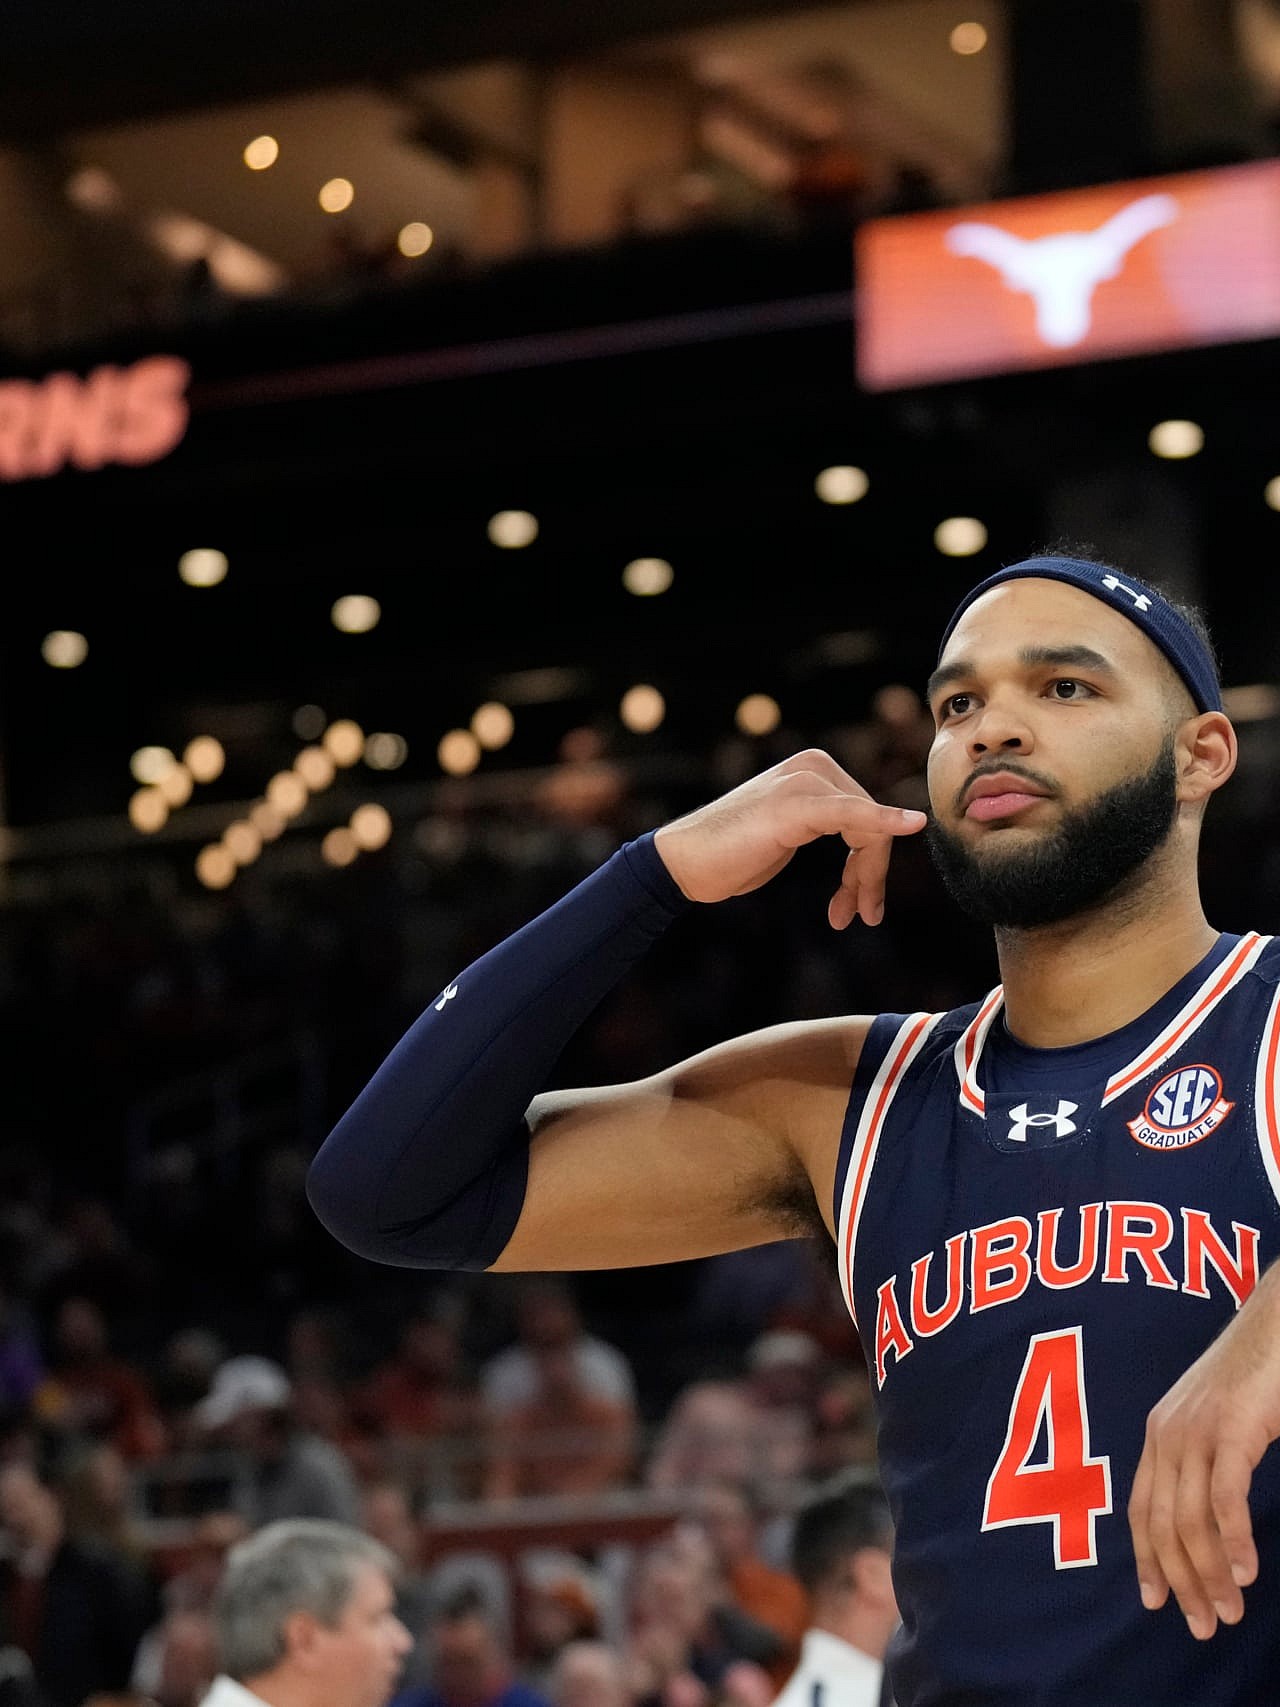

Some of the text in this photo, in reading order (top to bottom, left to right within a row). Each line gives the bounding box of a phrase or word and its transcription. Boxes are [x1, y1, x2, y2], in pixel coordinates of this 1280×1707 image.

[1137, 1115, 1218, 1148] GRADUATE
[1150, 1068, 1217, 1128] SEC
[874, 1200, 1261, 1392] AUBURN
[980, 1325, 1113, 1571] 4
